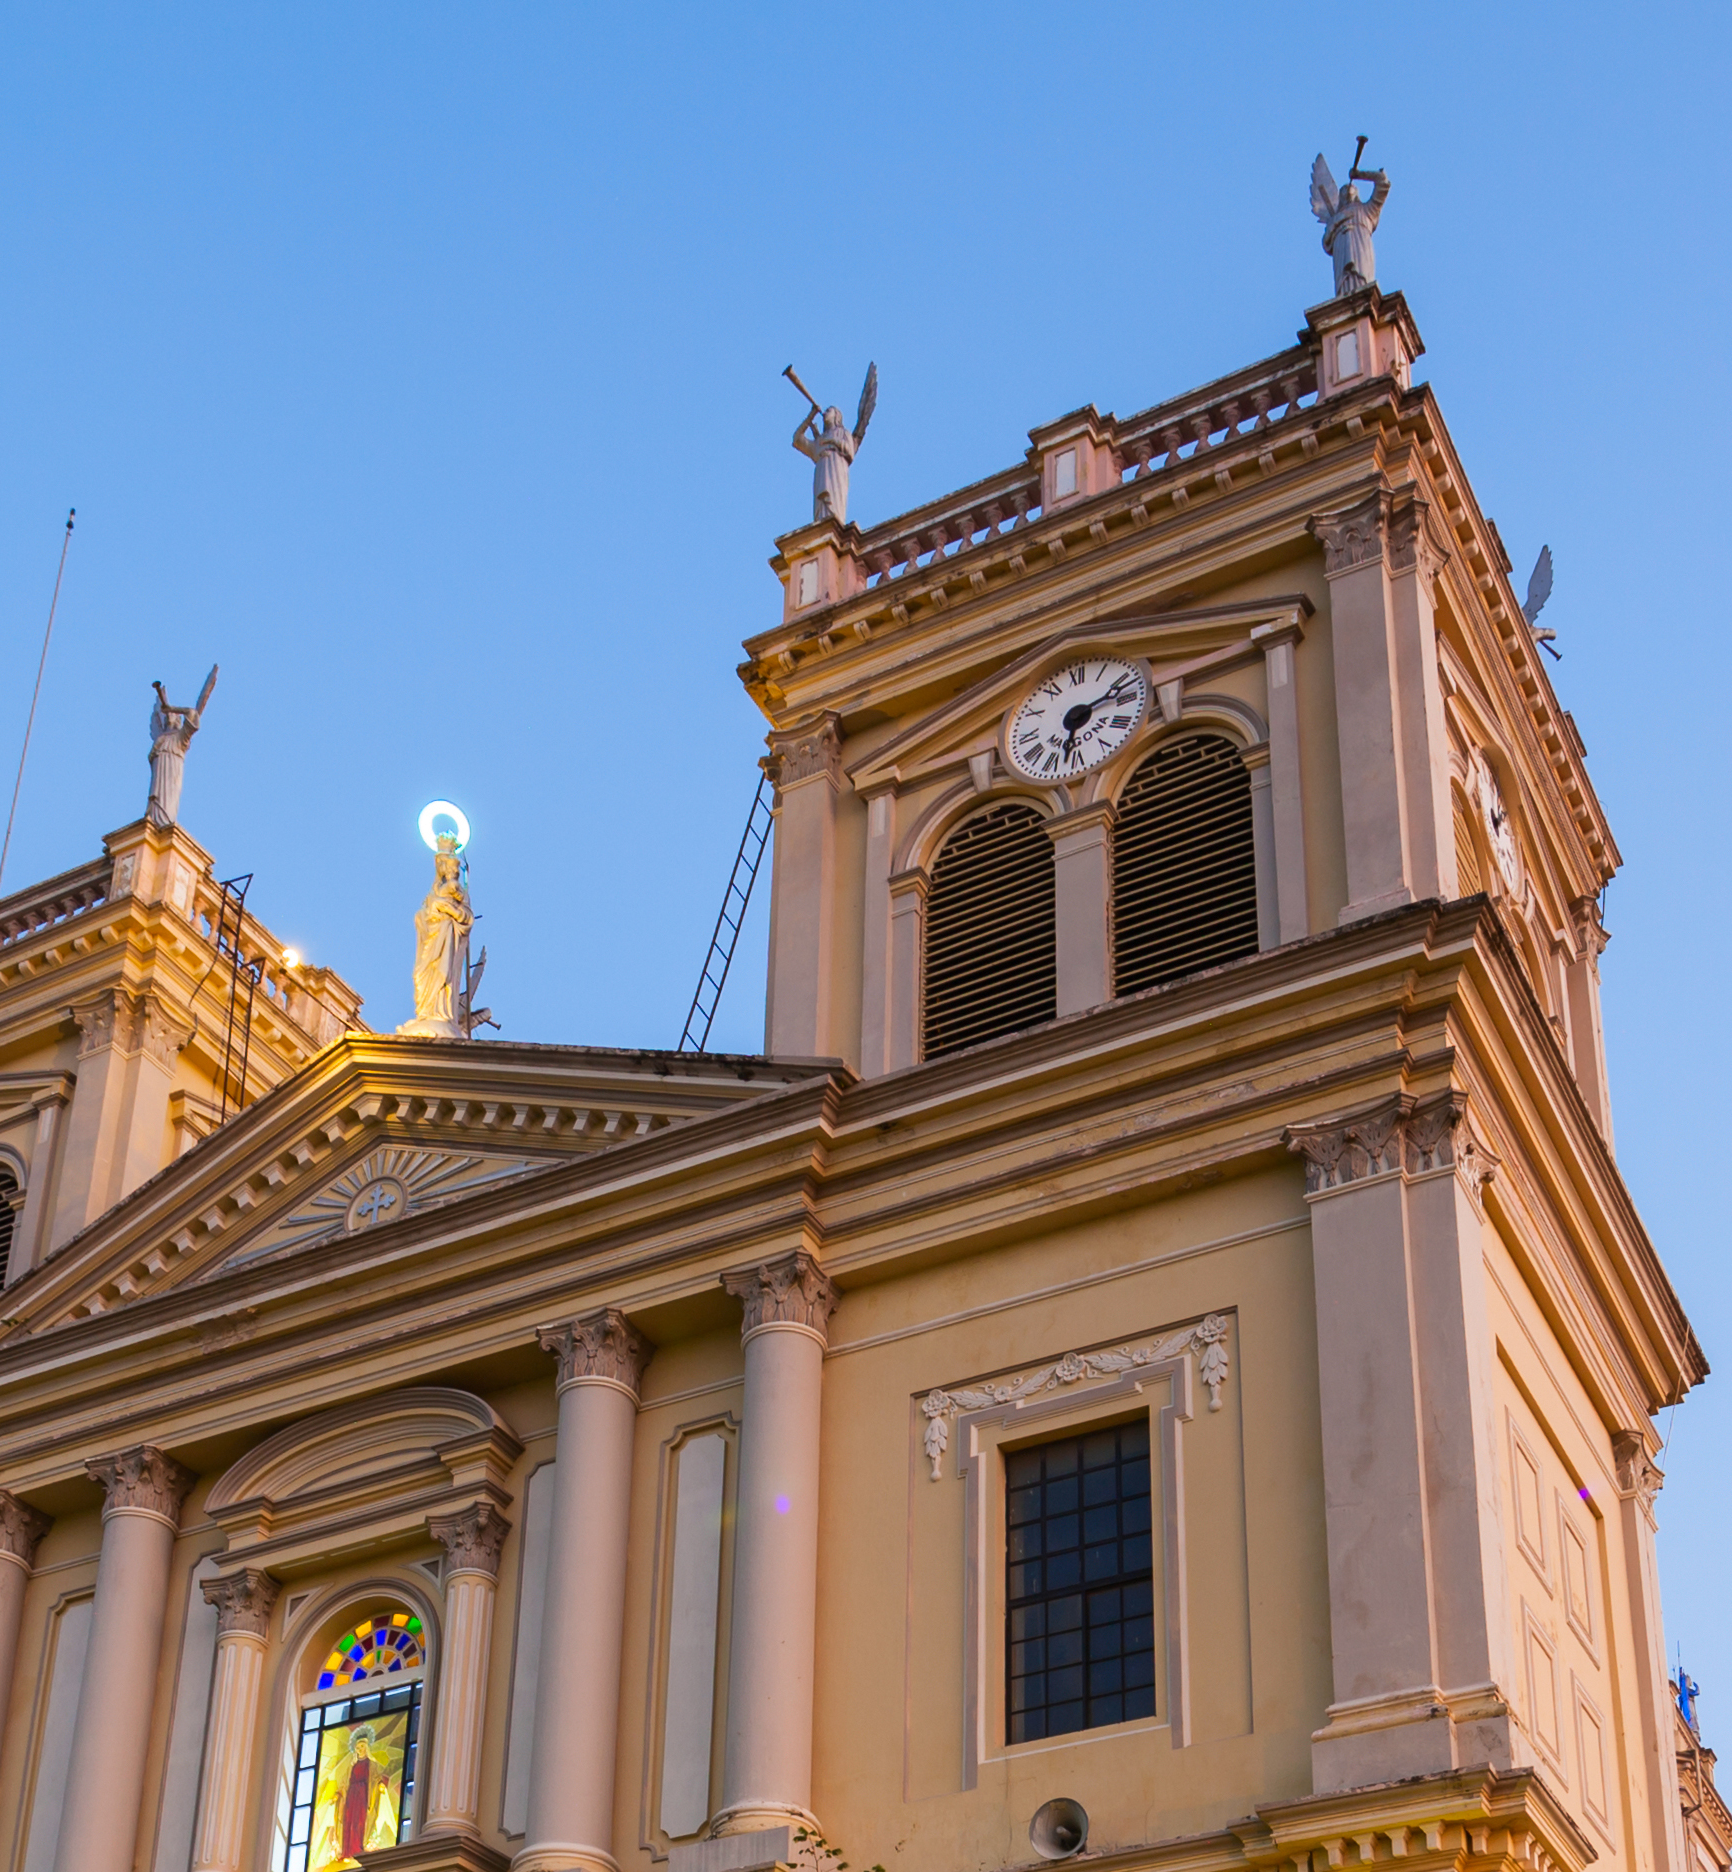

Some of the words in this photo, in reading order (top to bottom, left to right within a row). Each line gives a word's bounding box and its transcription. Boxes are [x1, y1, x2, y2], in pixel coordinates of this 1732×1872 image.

[1069, 665, 1085, 687] XII
[1043, 682, 1063, 701] XI
[1025, 708, 1045, 718] X
[1098, 738, 1112, 753] V
